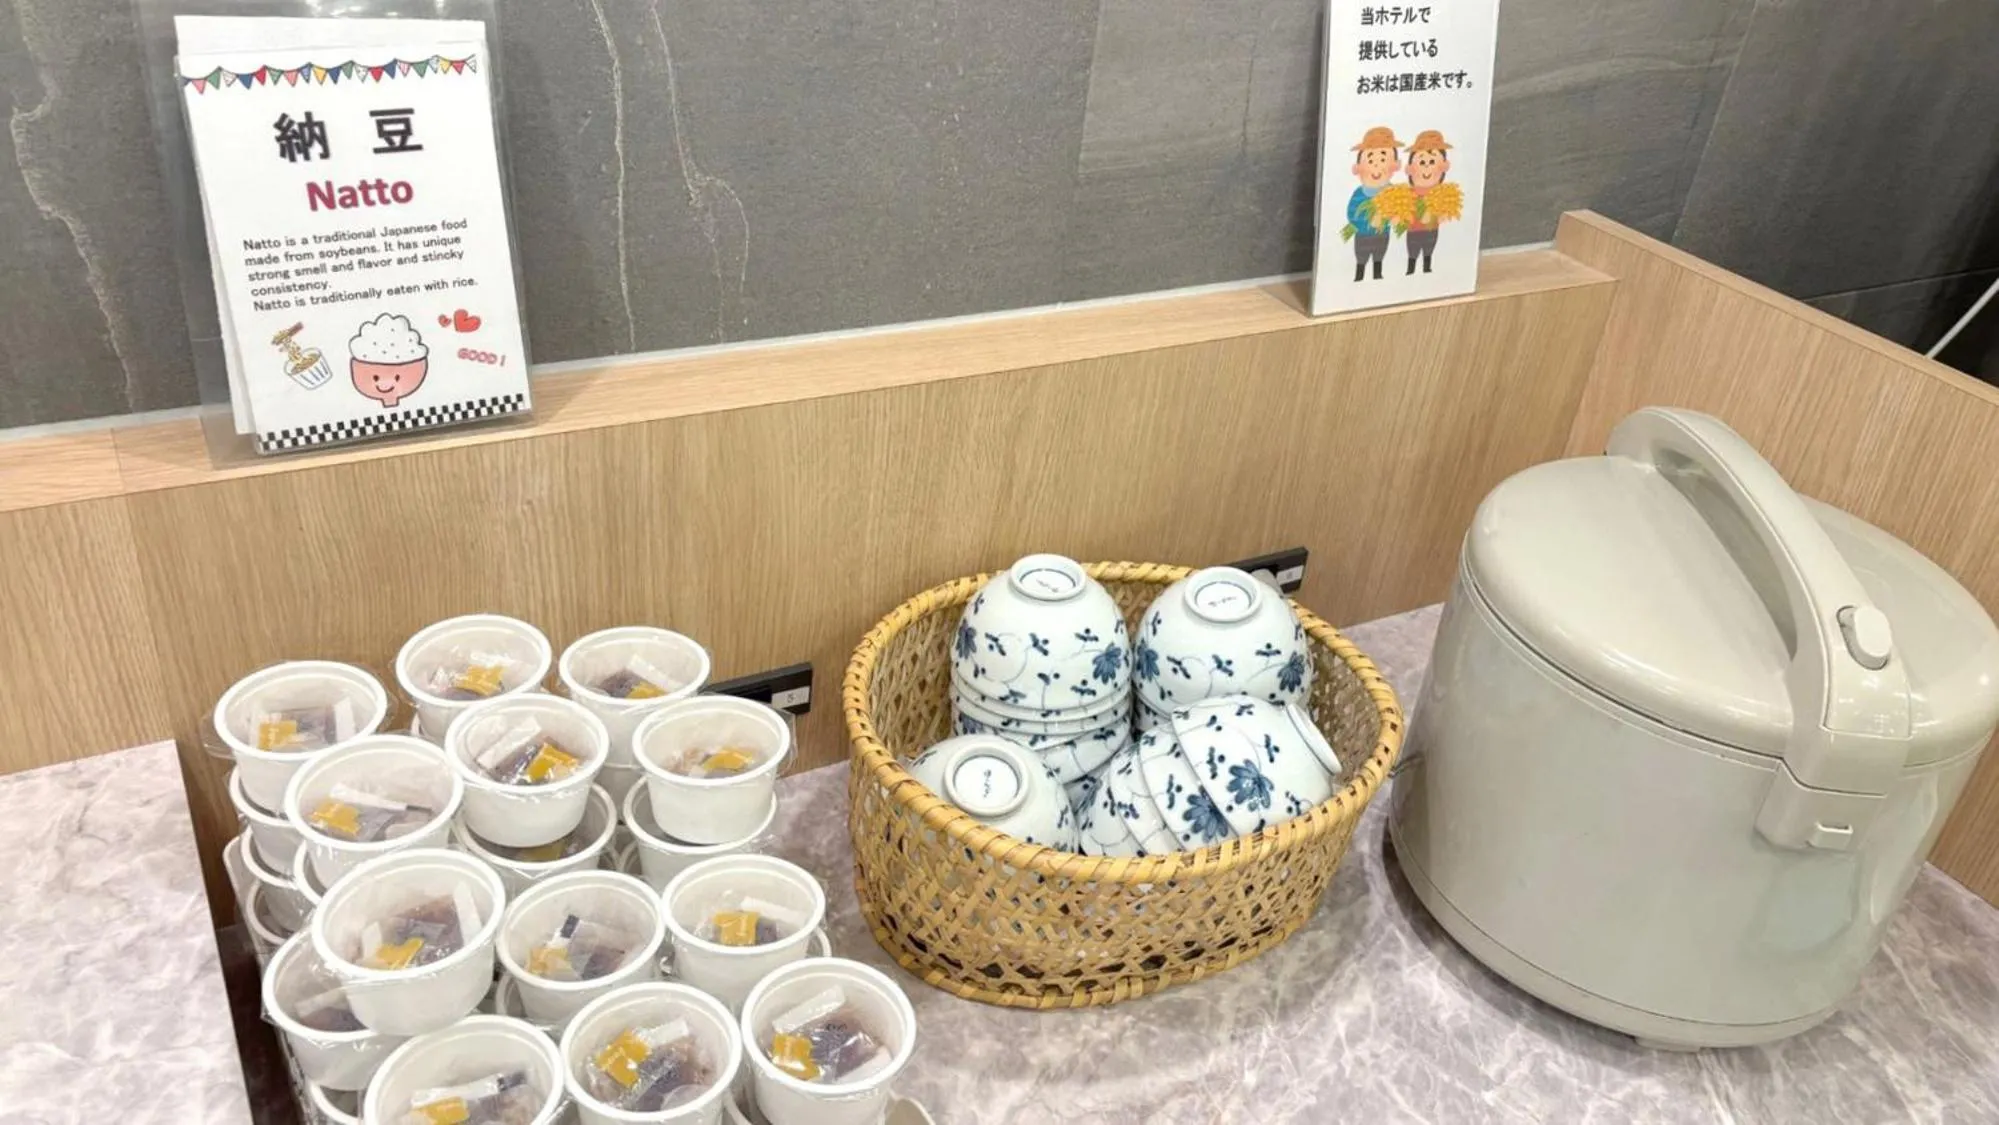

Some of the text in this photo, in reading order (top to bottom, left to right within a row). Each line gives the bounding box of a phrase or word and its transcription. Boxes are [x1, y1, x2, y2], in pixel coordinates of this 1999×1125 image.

[1361, 5, 1431, 26] 当ホテルで
[1359, 38, 1438, 61] 提供している
[1357, 69, 1473, 94] お米は国産米です。
[306, 178, 413, 212] Natto
[243, 218, 468, 251] Natto is a traditional Japanese food
[245, 235, 462, 267] made from soybeans. It has unique
[248, 248, 464, 282] strong smell and flavor and stincky
[251, 278, 332, 297] consistency.
[253, 275, 478, 311] Natto is traditionally eaten with rice.
